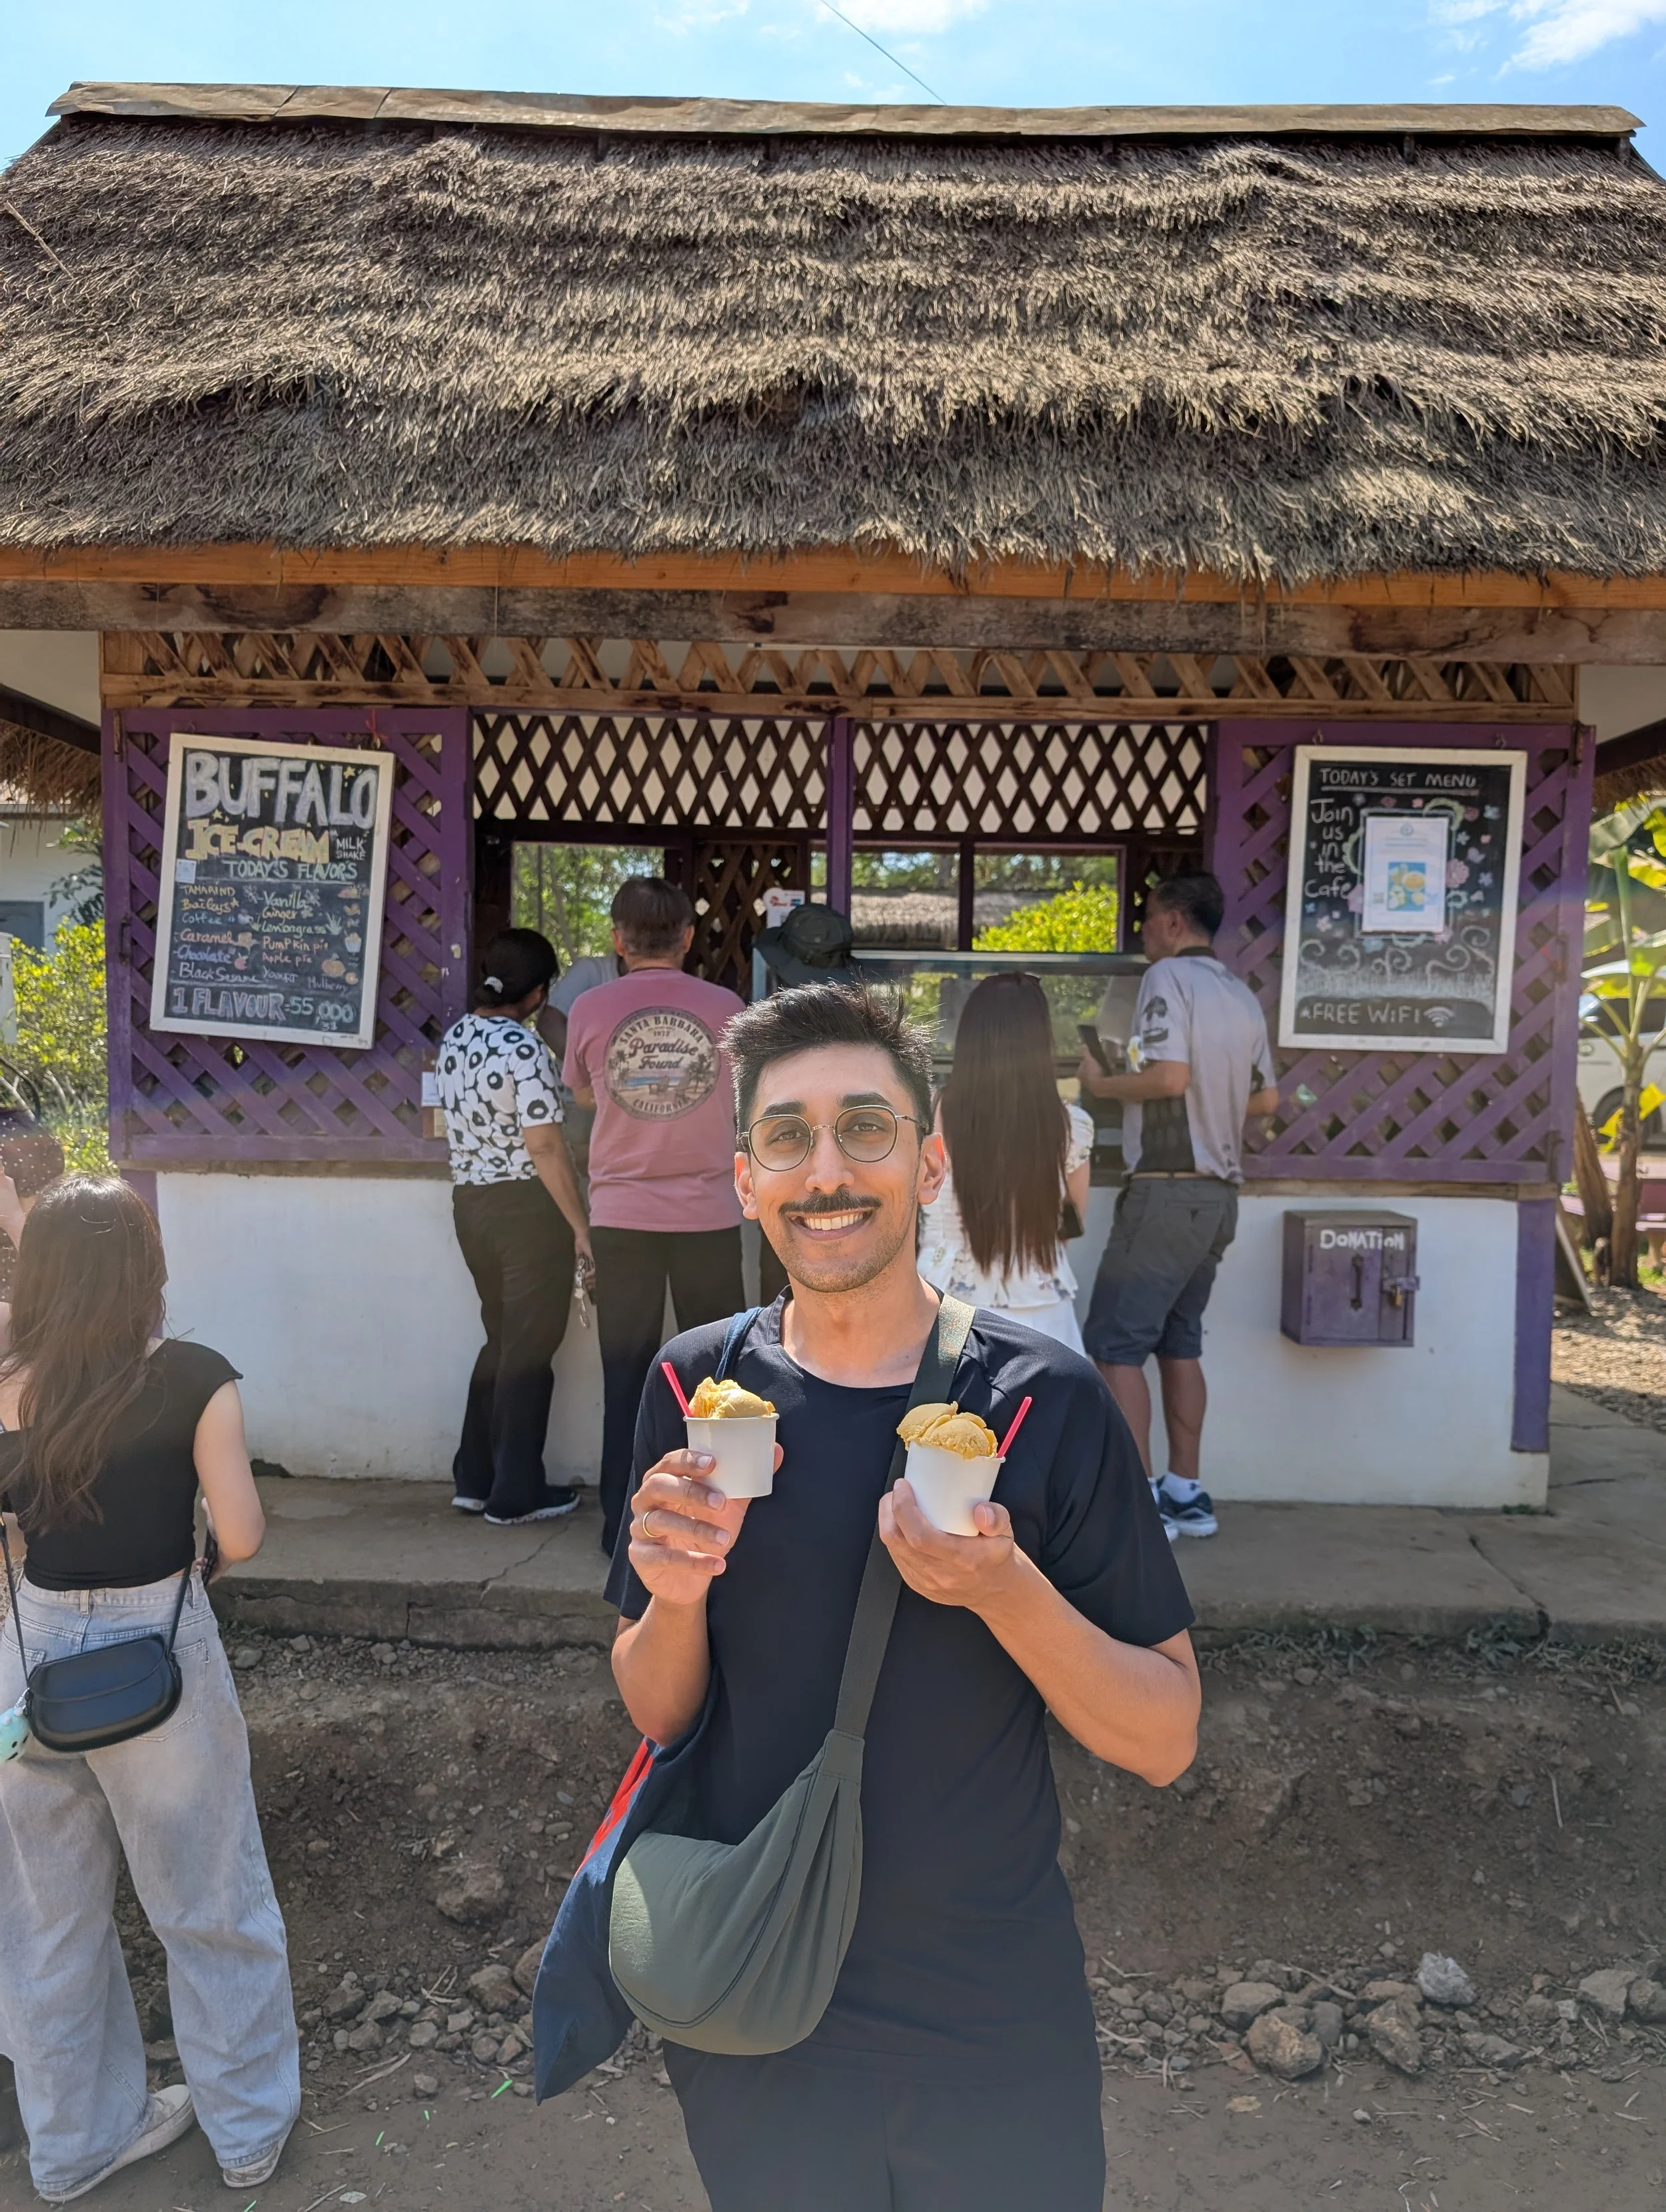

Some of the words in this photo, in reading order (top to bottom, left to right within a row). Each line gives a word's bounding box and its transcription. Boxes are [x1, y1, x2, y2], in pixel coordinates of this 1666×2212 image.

[1319, 768, 1379, 786] TODAY'S
[1389, 772, 1417, 787] SET
[1425, 773, 1476, 788] MENU
[186, 752, 378, 830] BUFFALO
[1310, 798, 1354, 827] Join
[1322, 826, 1344, 841] us
[336, 837, 367, 853] MILK
[336, 849, 366, 861] SHAKE
[1314, 854, 1346, 874] the
[181, 897, 232, 915] Baileys
[180, 928, 233, 944] Caramel
[179, 961, 215, 981] Black
[173, 987, 188, 1014] 1
[192, 987, 287, 1021] FLAVOUR
[1313, 1002, 1361, 1024] FREE
[620, 1019, 650, 1044] SANTA
[654, 1016, 704, 1043] BARBARA
[628, 1037, 700, 1059] Paradise
[638, 1055, 685, 1069] Found
